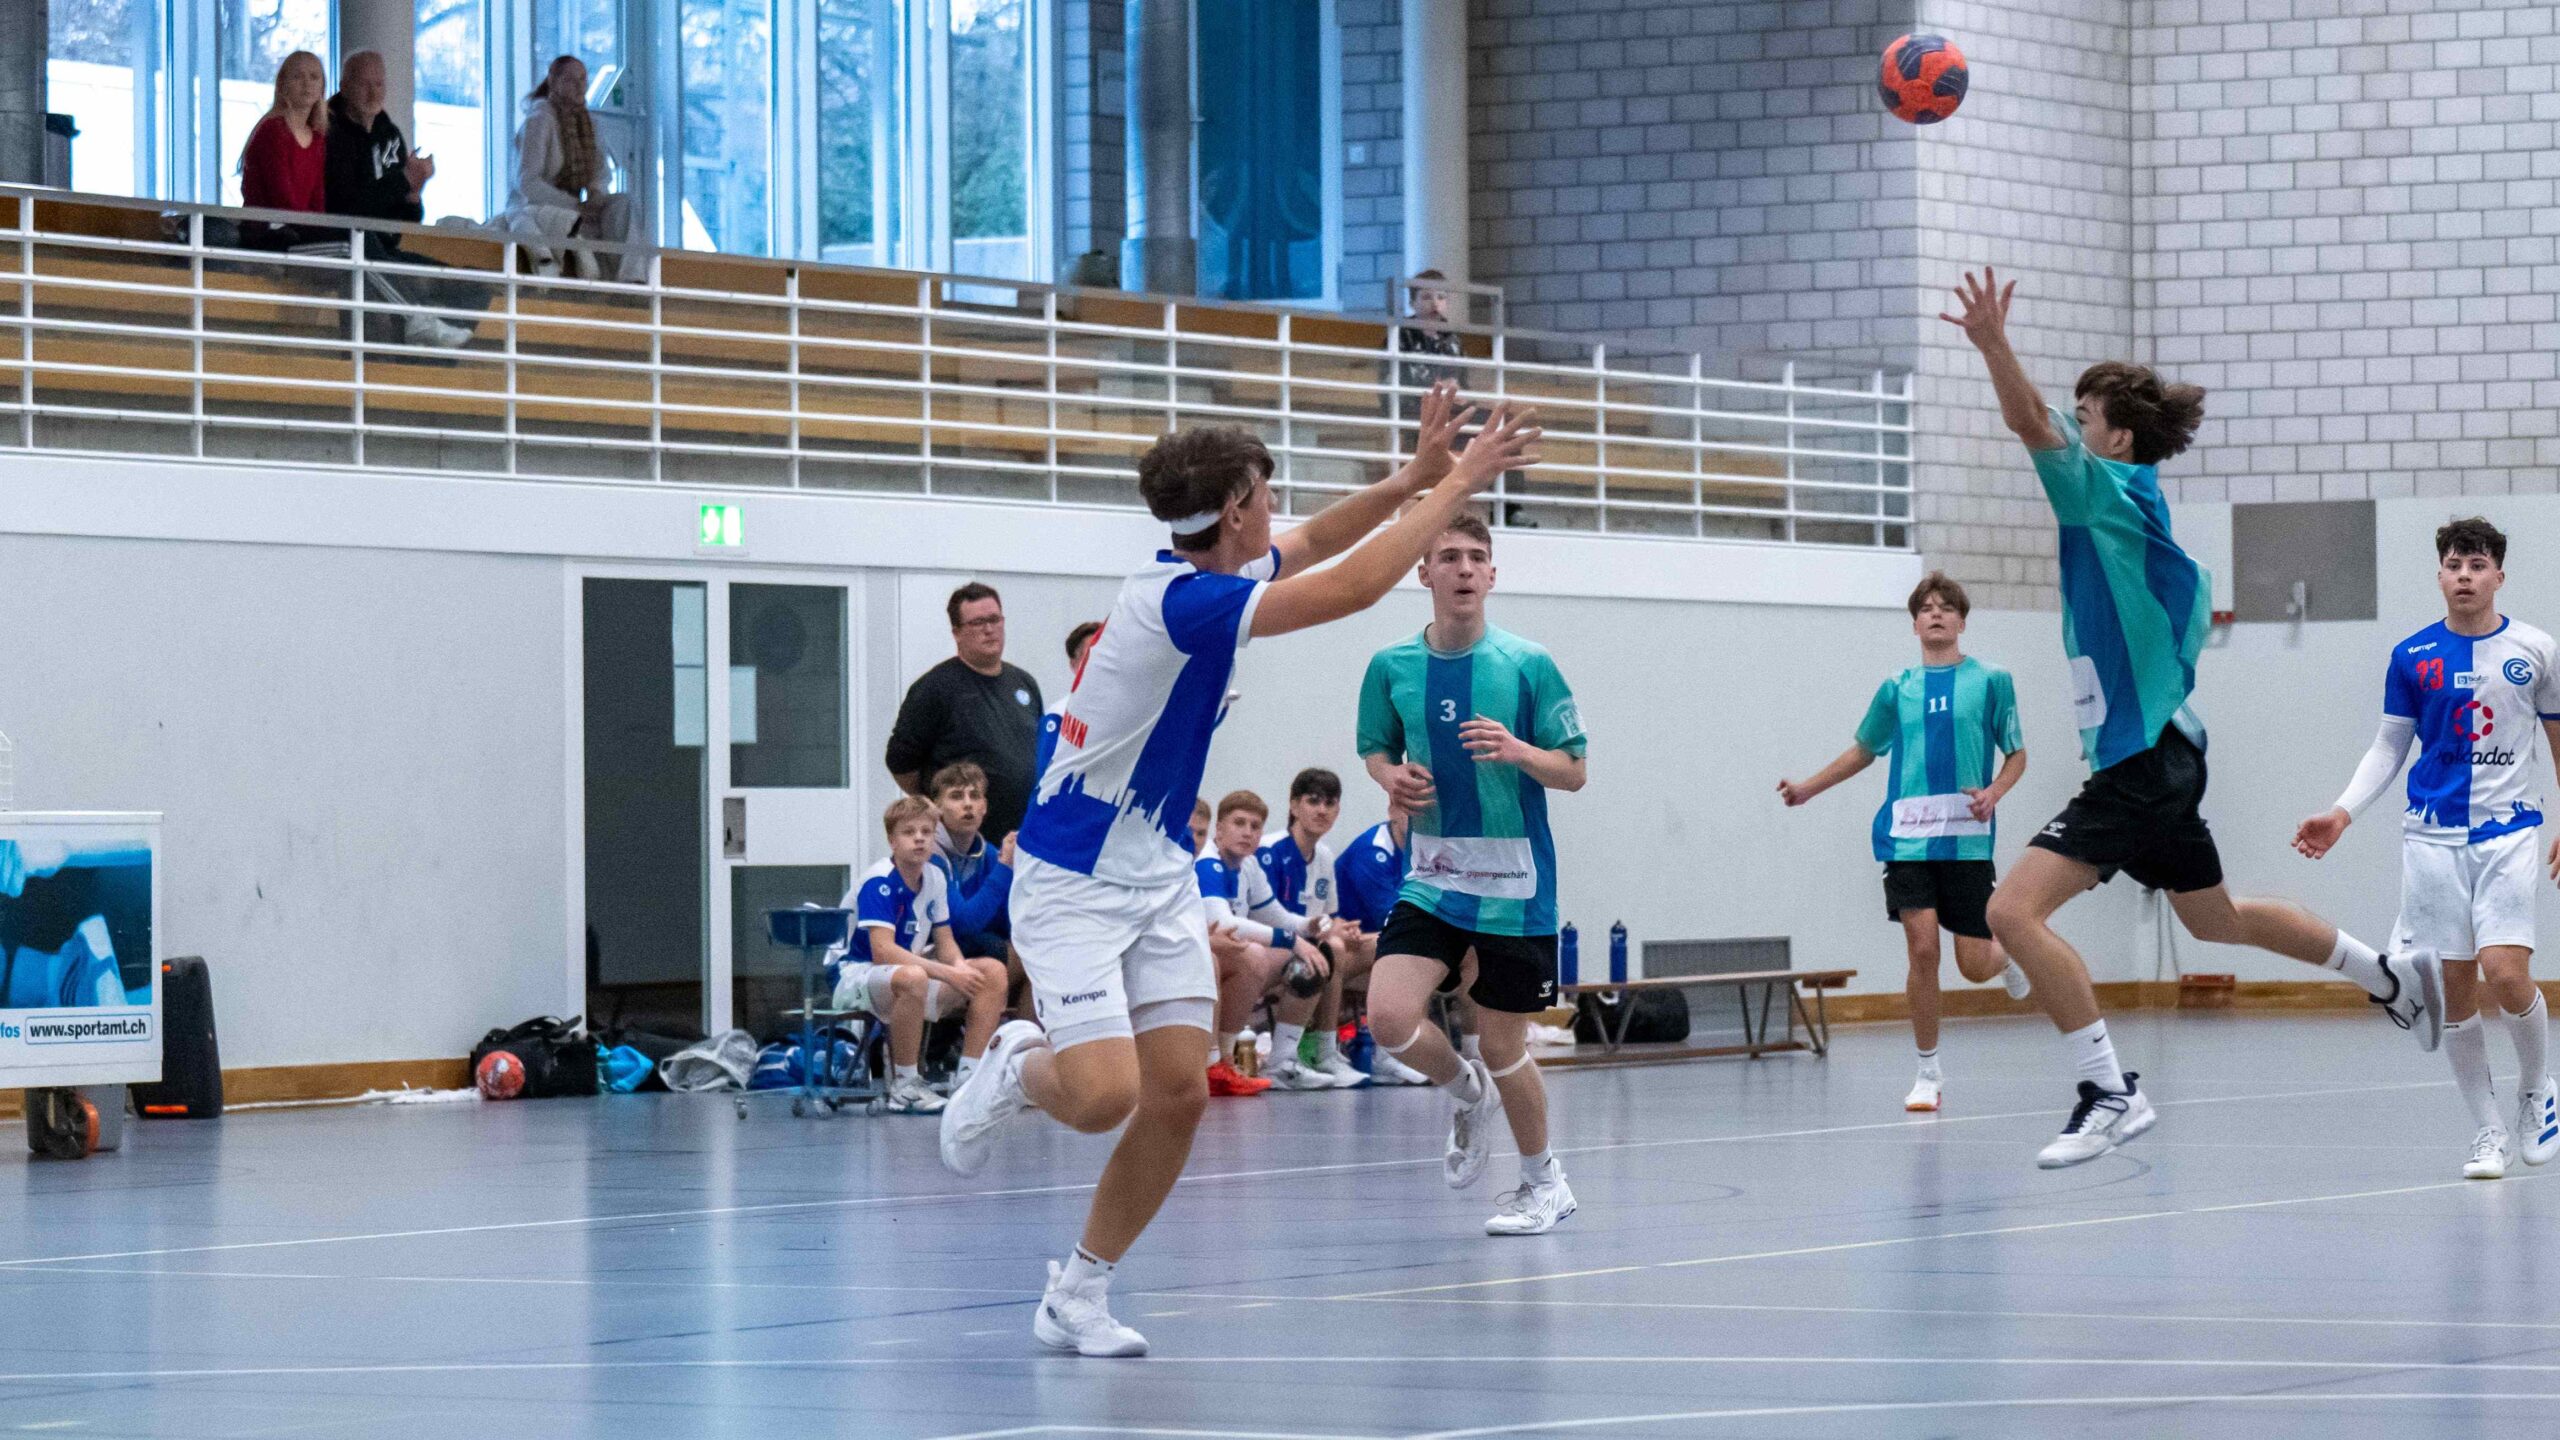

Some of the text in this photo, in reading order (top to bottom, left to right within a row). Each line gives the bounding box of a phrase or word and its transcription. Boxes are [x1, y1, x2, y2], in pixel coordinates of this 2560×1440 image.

[1440, 699, 1456, 721] 3
[1928, 695, 1948, 714] 11
[1061, 989, 1108, 1006] Kempa
[29, 1018, 147, 1040] www.sportamt.ch
